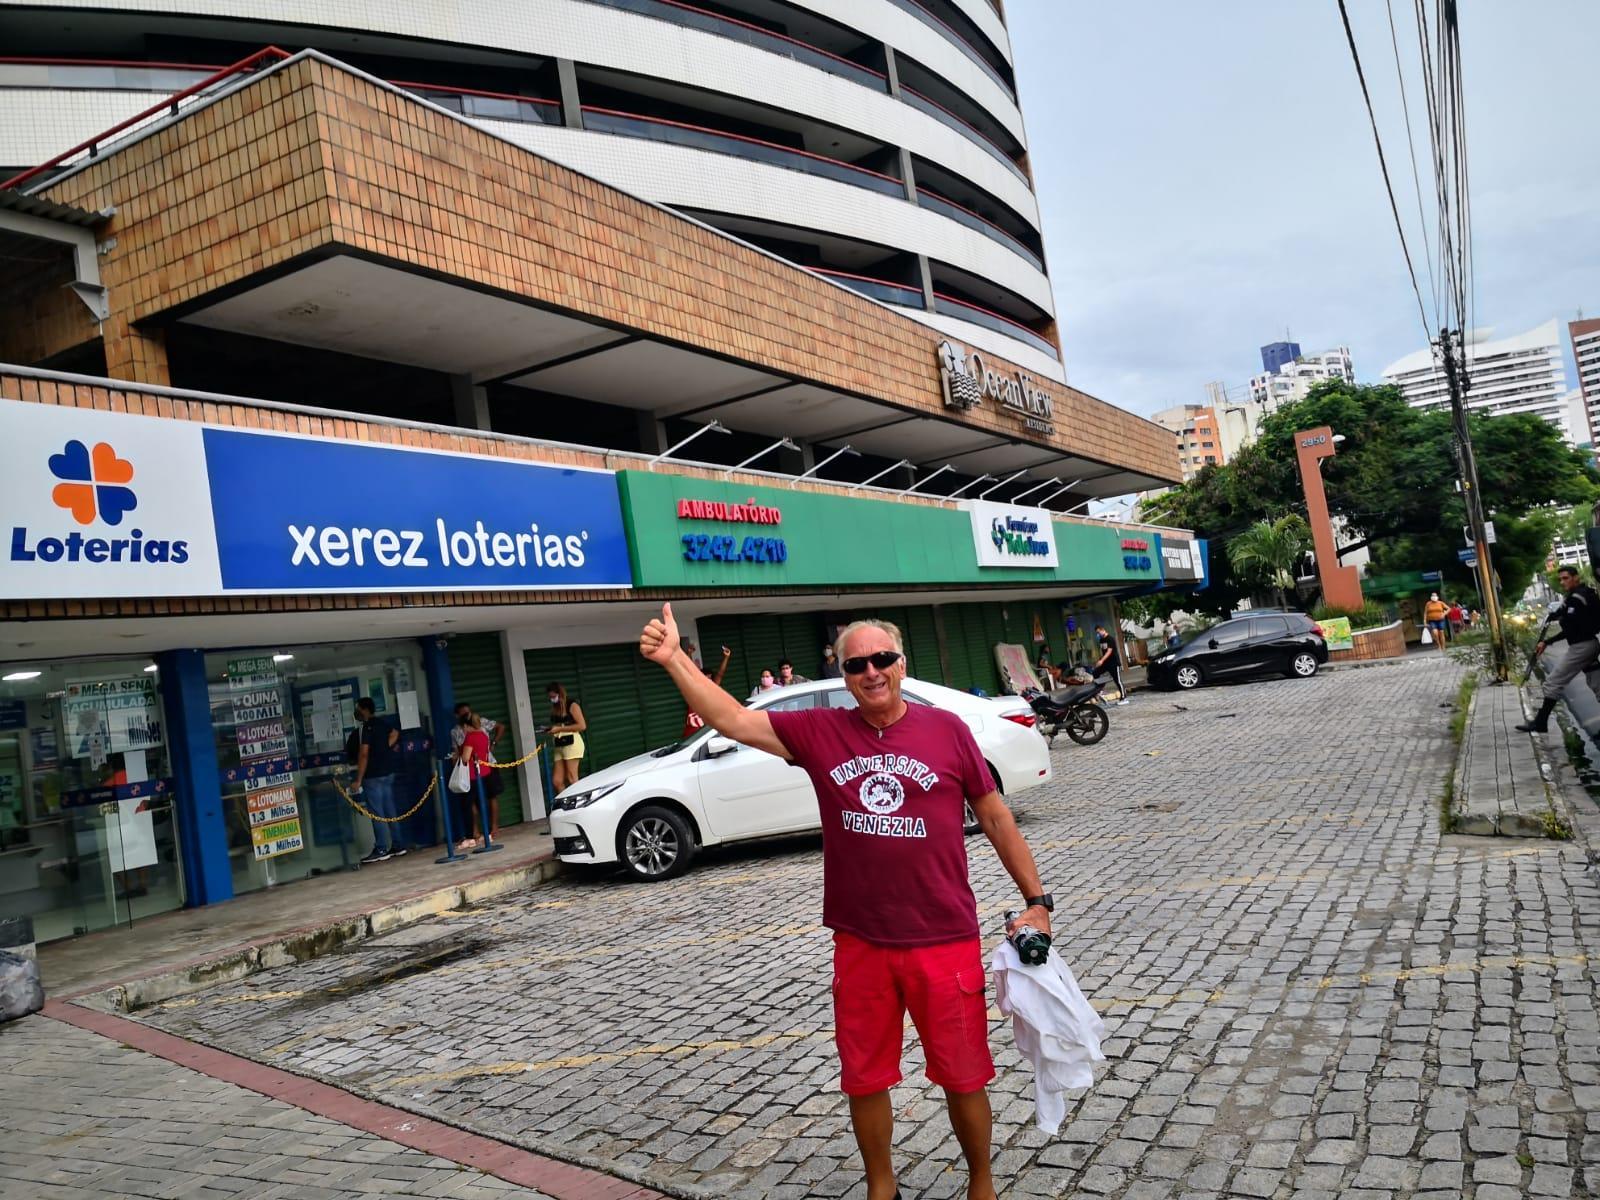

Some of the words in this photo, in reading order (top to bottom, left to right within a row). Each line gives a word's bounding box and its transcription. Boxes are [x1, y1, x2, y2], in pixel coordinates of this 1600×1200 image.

[1301, 434, 1326, 447] 2950
[678, 497, 782, 525] AMBULATÓRIO
[10, 526, 189, 564] Loterias
[287, 524, 429, 567] xerez
[682, 533, 788, 564] 3242.4210
[237, 661, 256, 673] MEGA
[81, 681, 117, 697] MEGA
[120, 678, 154, 692] SENA
[70, 696, 154, 712] ACUMULADA
[242, 691, 278, 706] QUINA
[256, 707, 281, 718] MIL
[241, 744, 255, 755] 4.1
[830, 754, 940, 791] UNIVERSITA
[246, 779, 260, 789] 30
[257, 790, 294, 807] LOTOMANIA
[251, 811, 266, 823] 1.3
[271, 805, 296, 819] Milhão
[262, 823, 298, 840] TIMEMANIA
[842, 810, 927, 838] VENEZIA
[257, 844, 271, 856] 1.2
[276, 838, 301, 852] Milhão
